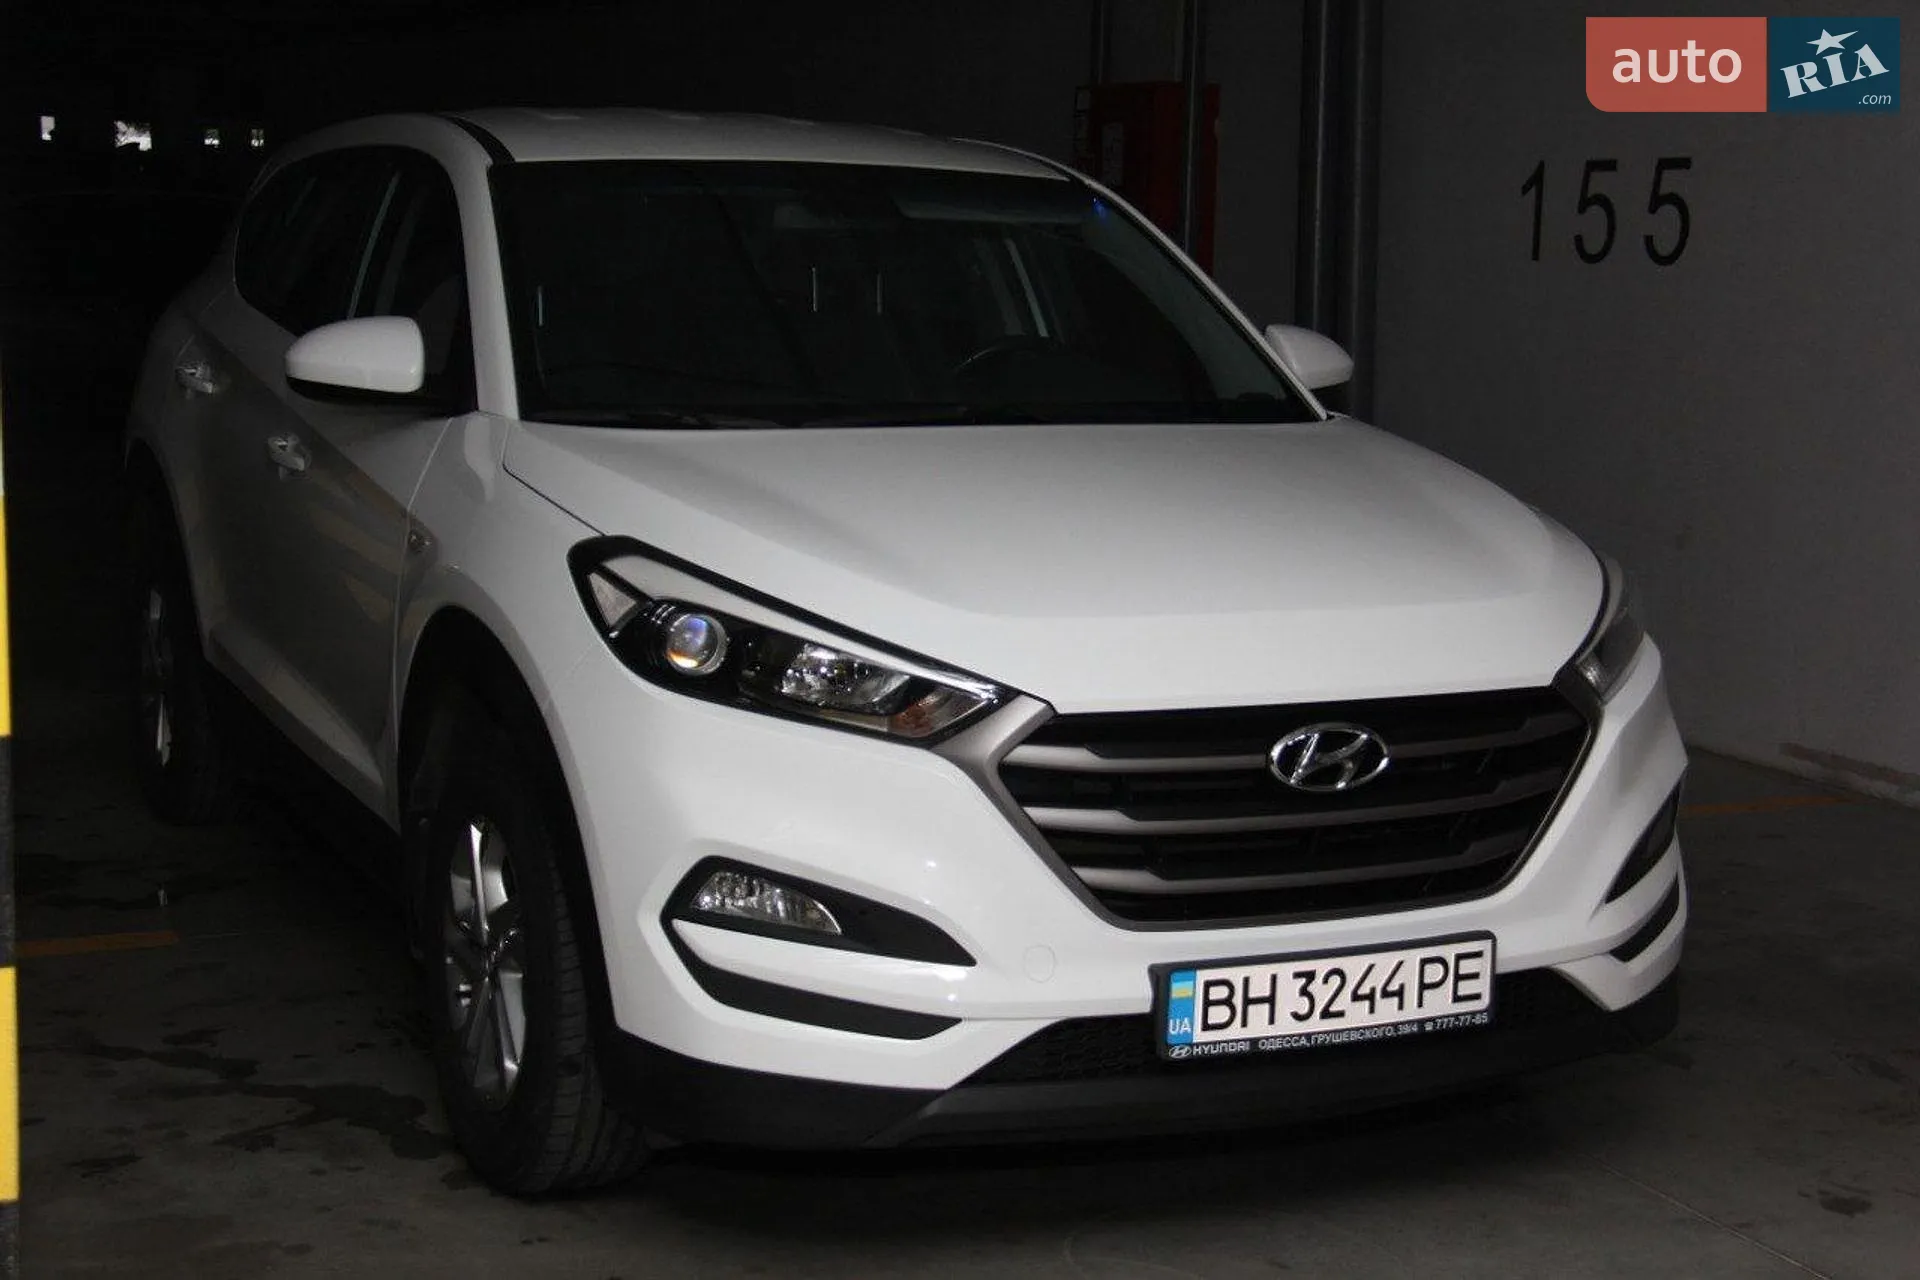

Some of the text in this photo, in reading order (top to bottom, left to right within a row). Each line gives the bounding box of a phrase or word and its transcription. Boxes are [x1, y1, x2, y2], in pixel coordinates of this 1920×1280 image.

[1521, 157, 1692, 266] 155
[1168, 1017, 1192, 1035] UA
[1200, 973, 1277, 1031] BH
[1290, 960, 1405, 1022] 3244
